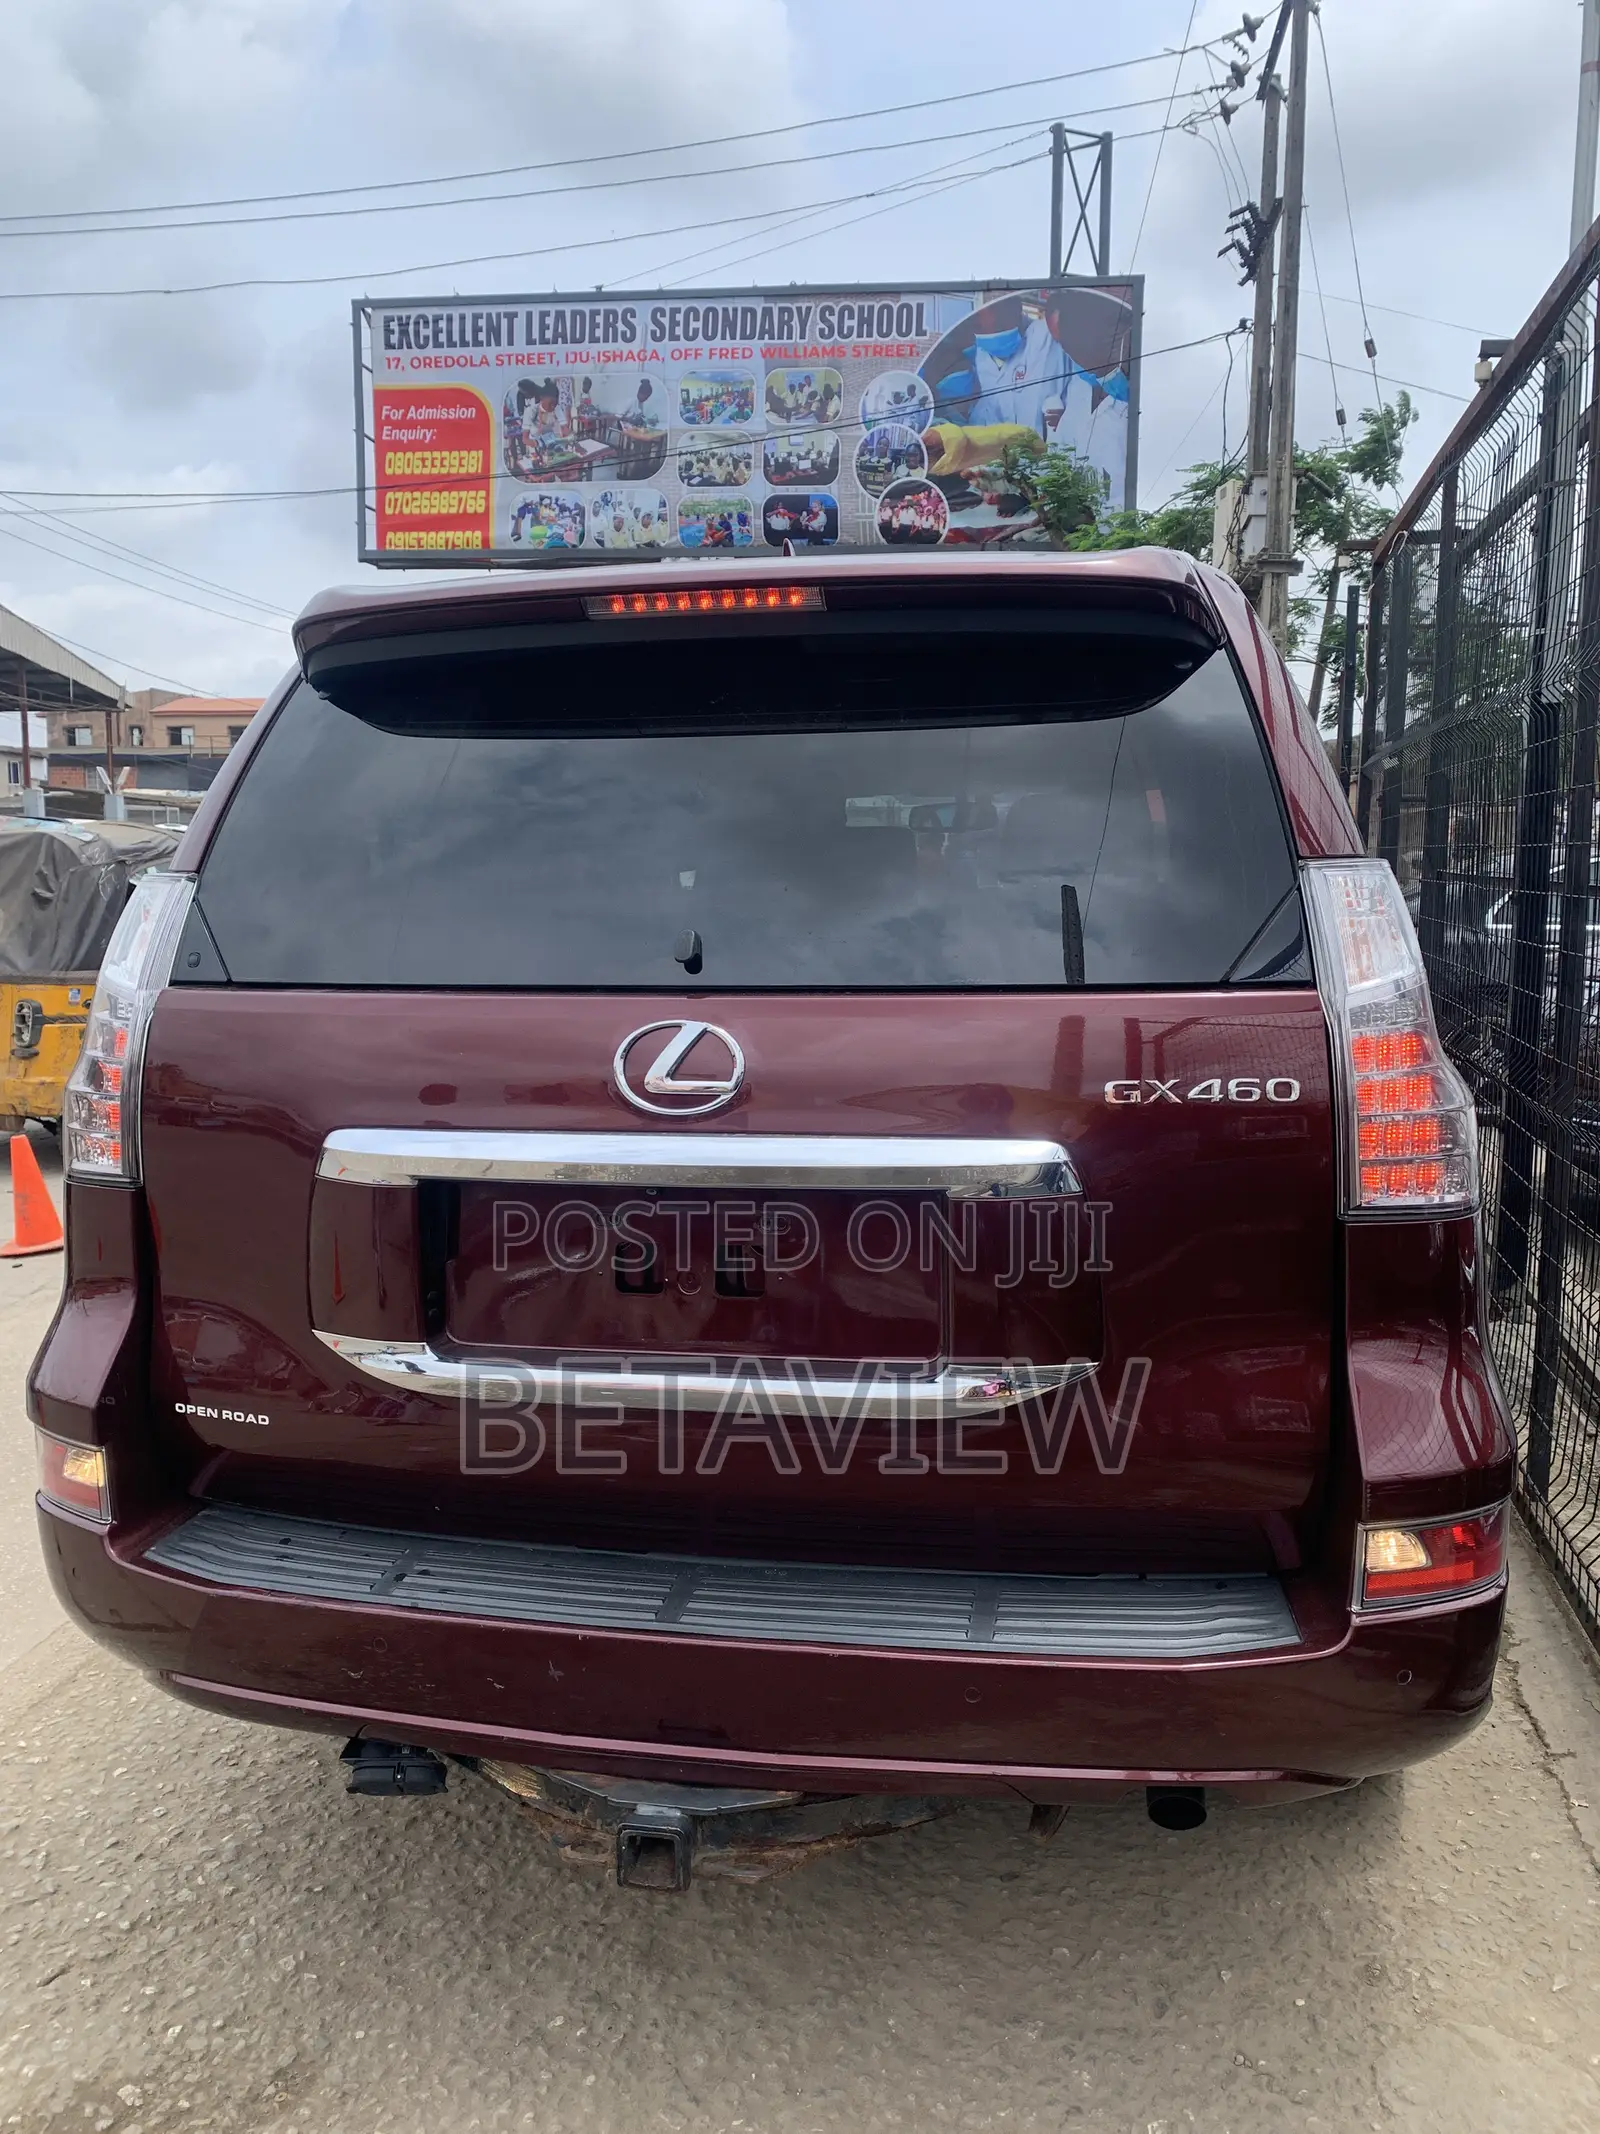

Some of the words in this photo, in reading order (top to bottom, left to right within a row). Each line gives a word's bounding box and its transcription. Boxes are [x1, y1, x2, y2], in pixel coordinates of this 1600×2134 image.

[383, 310, 519, 351] EXCELLENT
[525, 306, 637, 346] LEADERS
[650, 304, 813, 343] SECONDARY
[818, 302, 928, 341] SCHOOL
[385, 356, 406, 371] 17,
[410, 354, 490, 370] OREDOLA
[496, 351, 560, 367] STREET,
[565, 348, 665, 365] IJU-ISHAGA,
[671, 347, 703, 362] OFF
[708, 346, 754, 360] FRED
[760, 344, 847, 359] WILLIAMS
[851, 343, 920, 358] STREET.
[381, 405, 405, 420] For
[406, 404, 477, 420] Admission
[382, 425, 437, 444] Enquiry:
[385, 450, 484, 476] 08063339381
[385, 490, 487, 515] 07026989766
[175, 1402, 219, 1419] OPEN
[221, 1409, 270, 1425] ROAD
